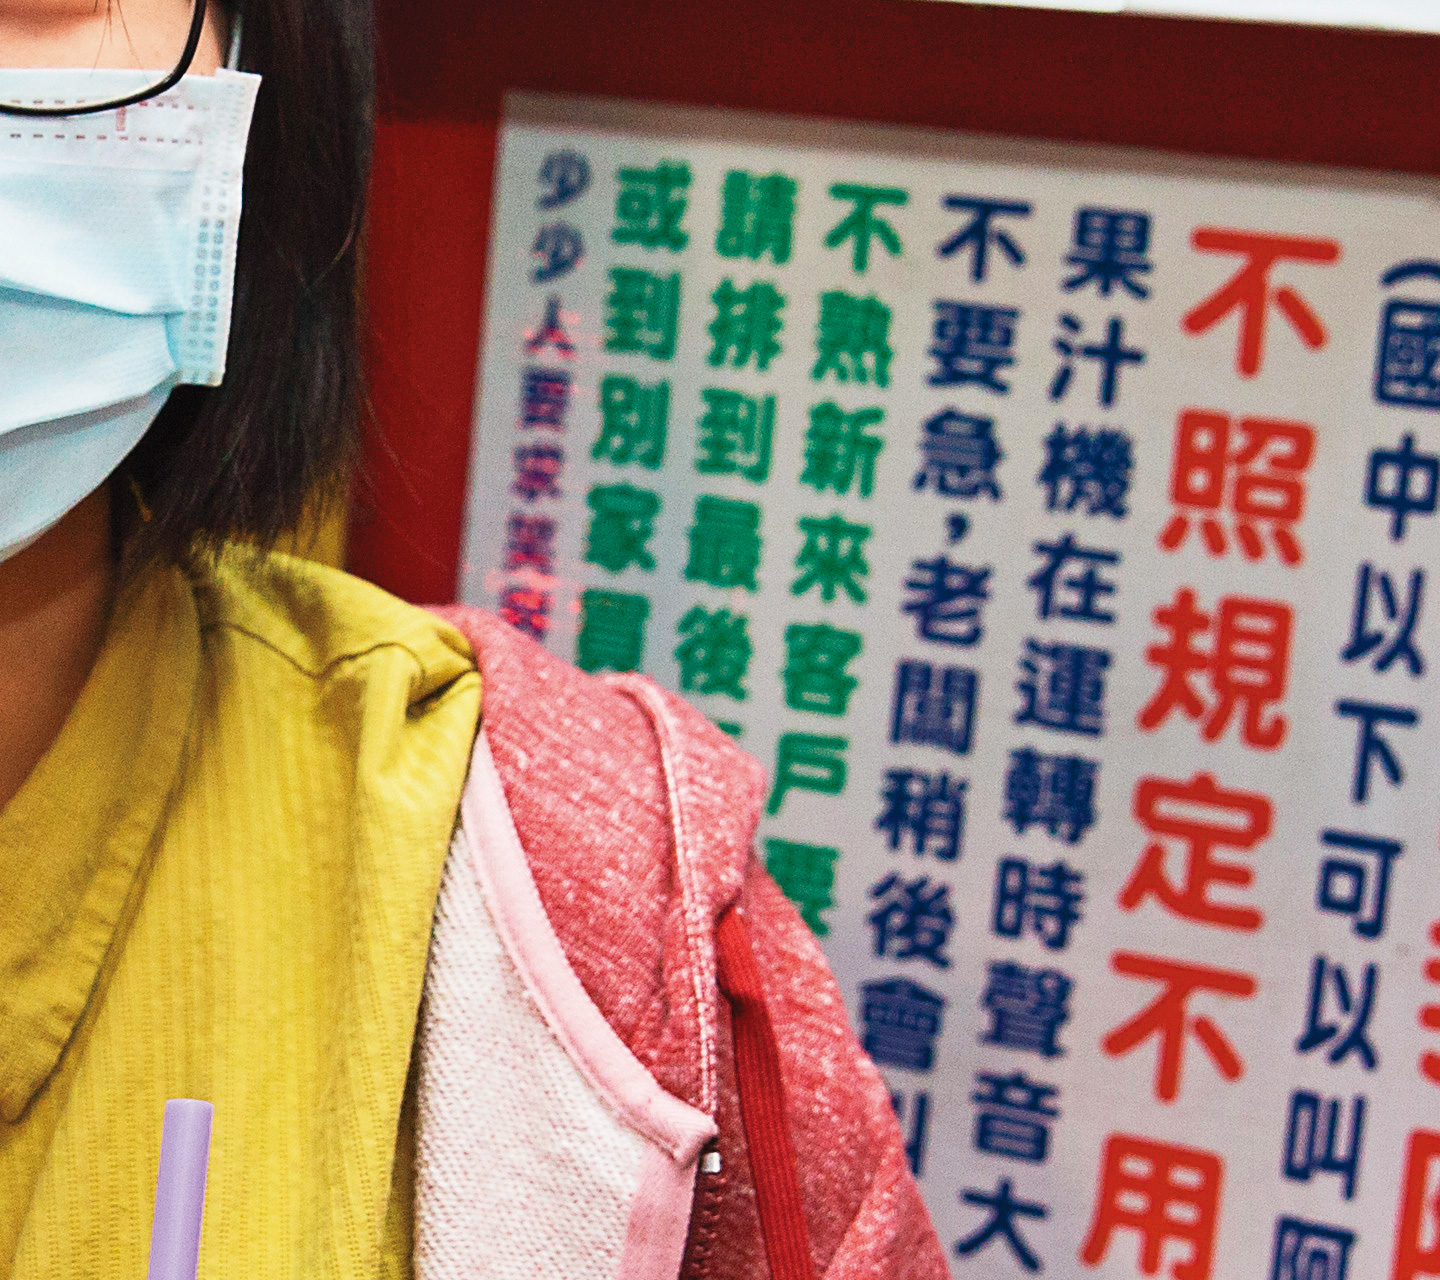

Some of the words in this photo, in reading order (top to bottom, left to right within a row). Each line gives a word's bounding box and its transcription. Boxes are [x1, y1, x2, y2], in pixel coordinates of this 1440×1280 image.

[674, 169, 800, 742] 請排到最後
[954, 204, 1156, 1274] 果汁機在運轉時聲音大
